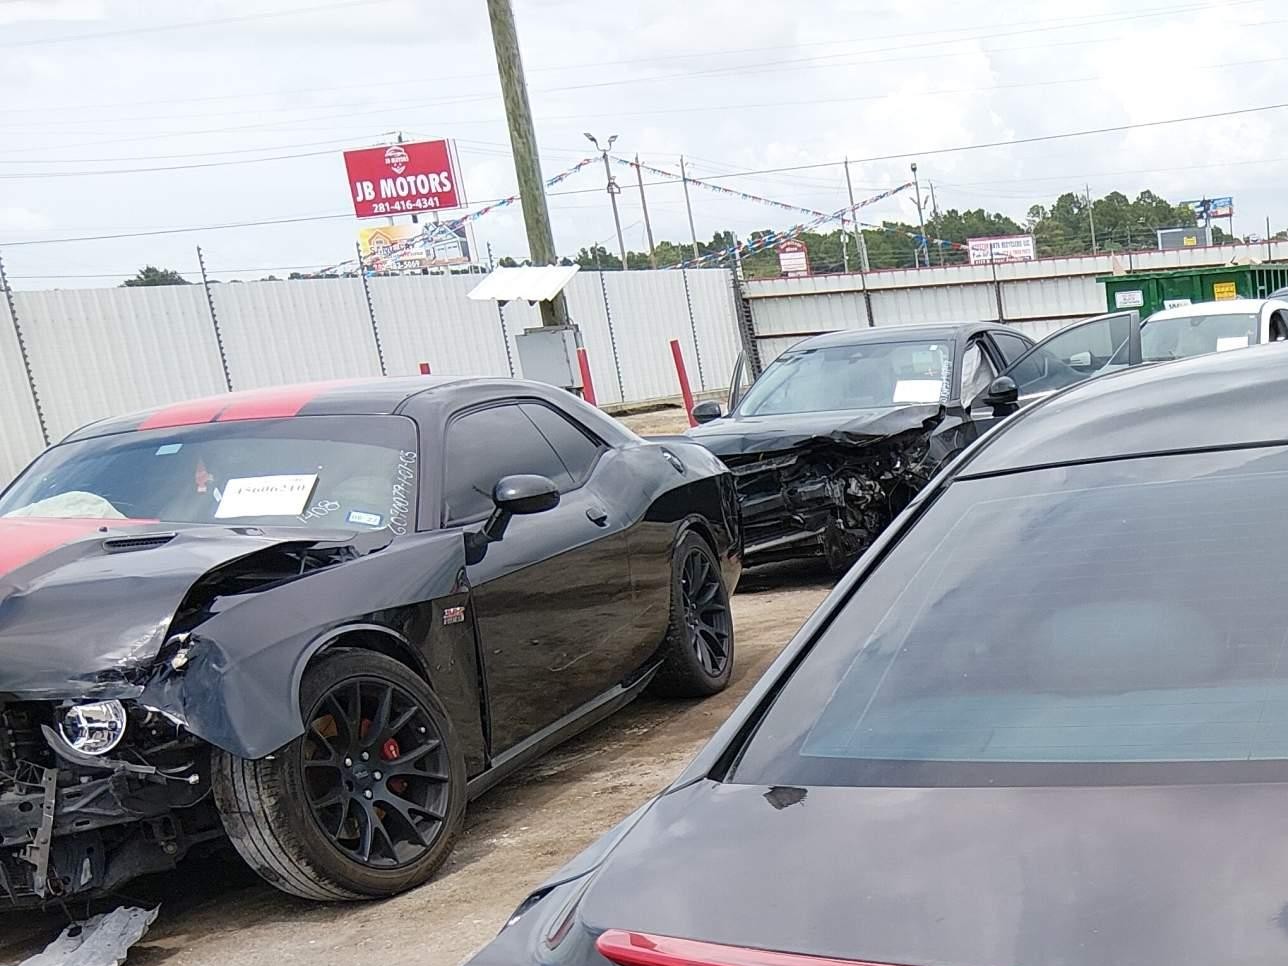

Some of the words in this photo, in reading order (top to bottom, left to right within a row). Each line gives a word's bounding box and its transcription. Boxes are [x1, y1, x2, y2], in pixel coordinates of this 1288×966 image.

[355, 180, 376, 202] JB
[380, 171, 452, 199] MOTORS
[372, 196, 440, 213] 281-416-4341
